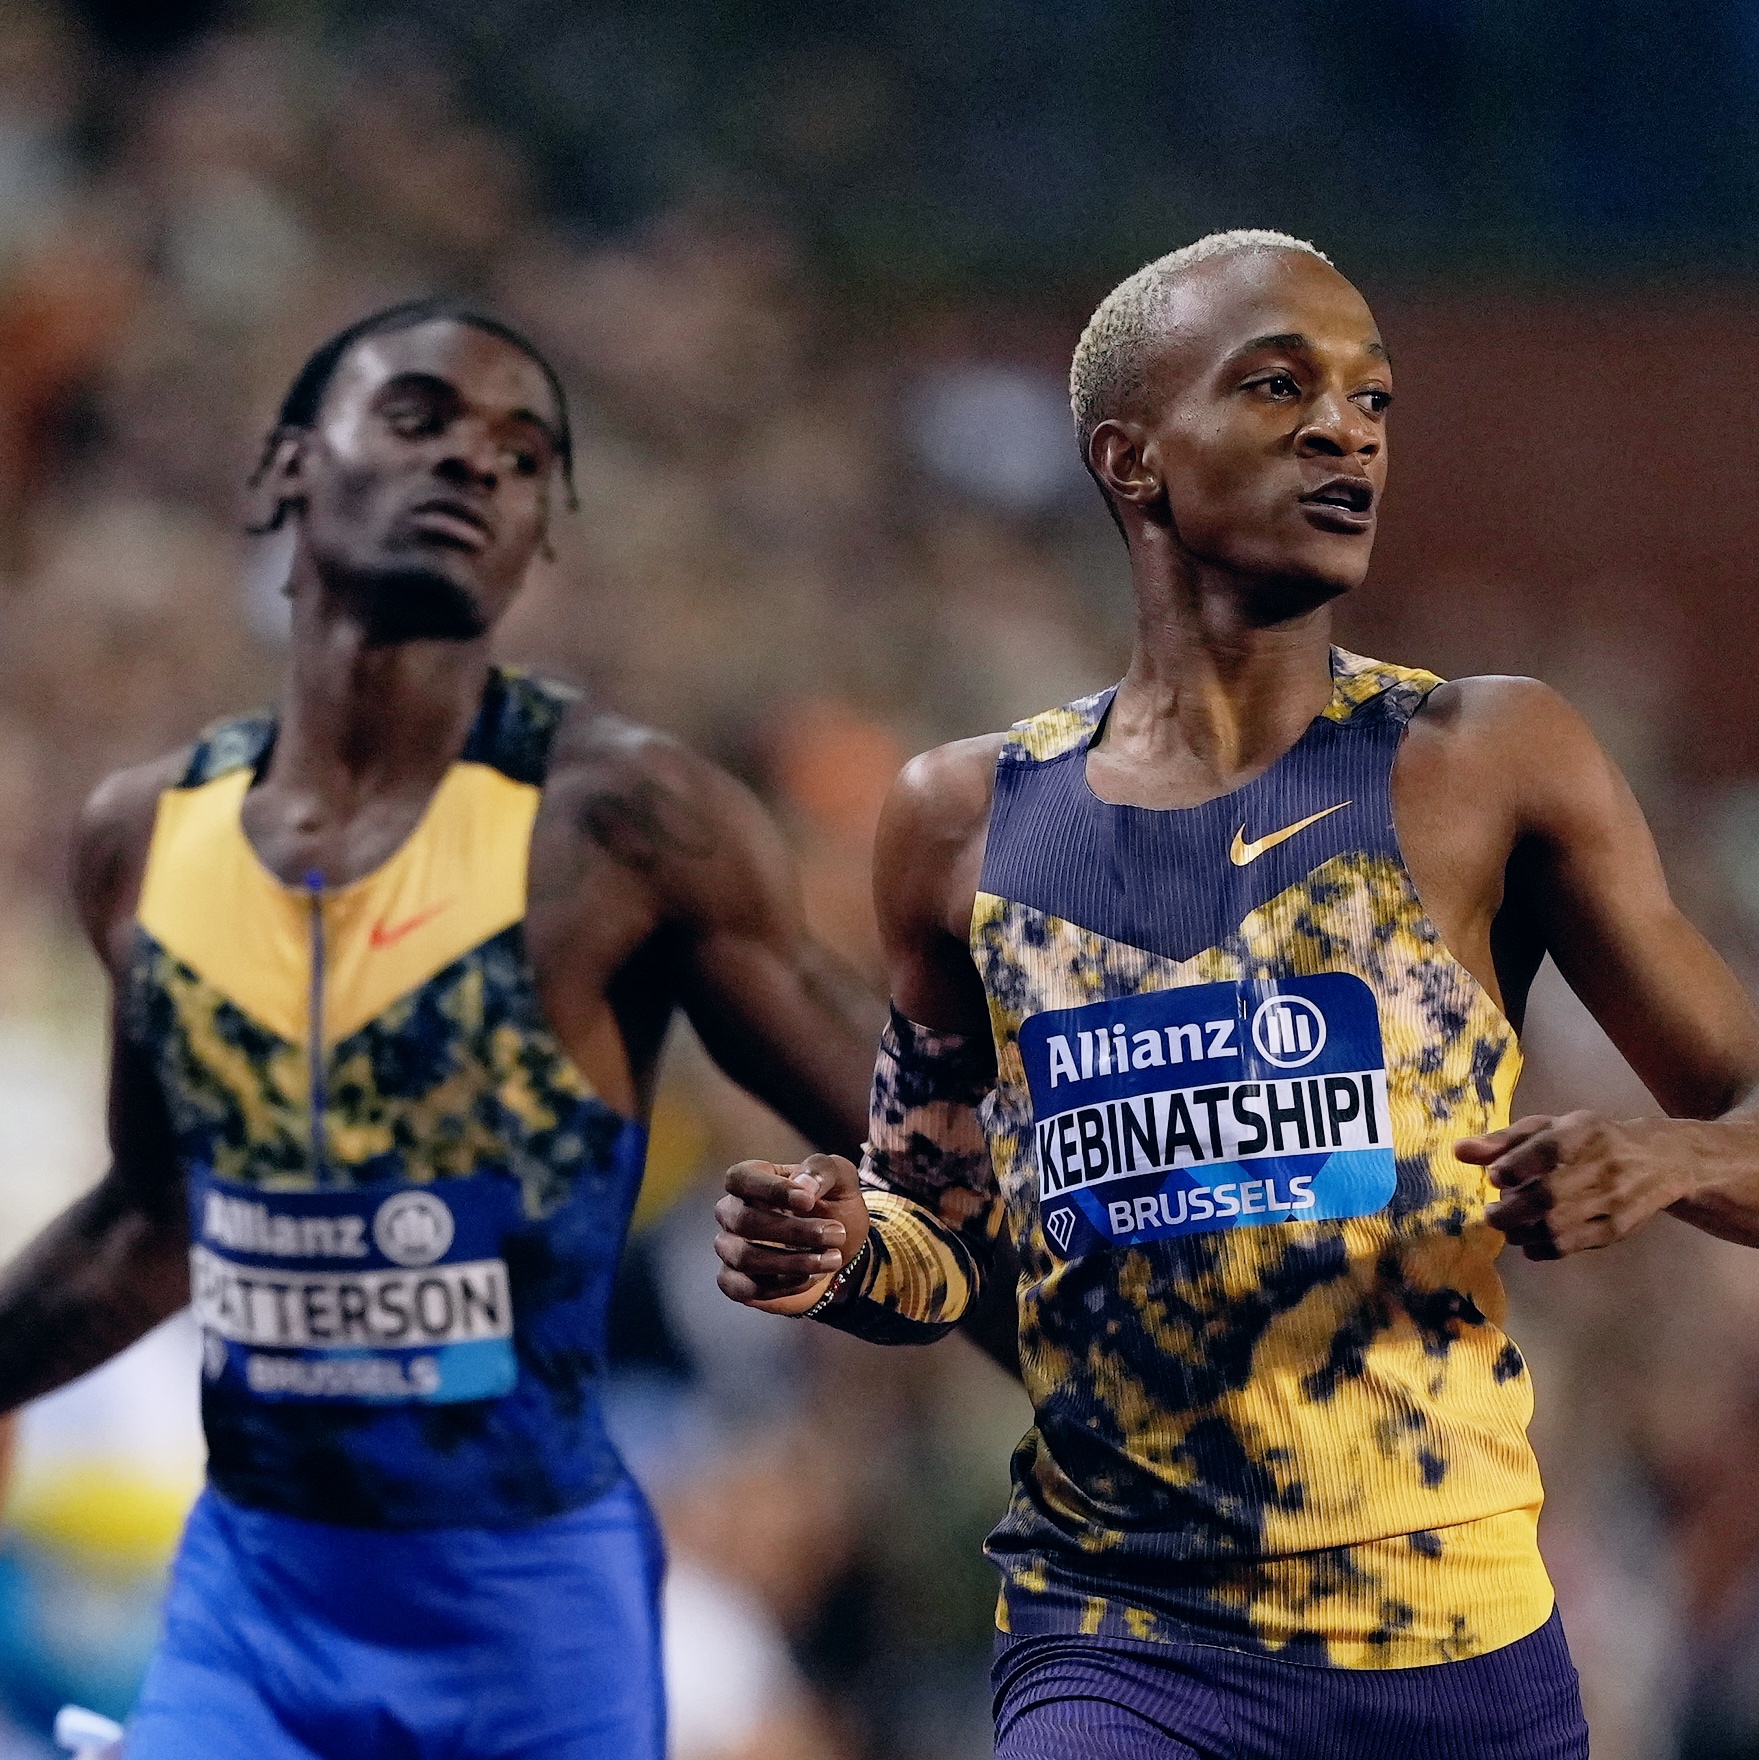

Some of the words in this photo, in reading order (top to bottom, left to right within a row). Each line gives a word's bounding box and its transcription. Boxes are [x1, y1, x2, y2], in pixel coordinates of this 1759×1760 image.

[1046, 1016, 1238, 1089] Allianz
[1039, 1074, 1379, 1195] KEBINATSHIPI
[203, 1188, 369, 1259] Allianz
[1108, 1175, 1316, 1235] BRUSSELS
